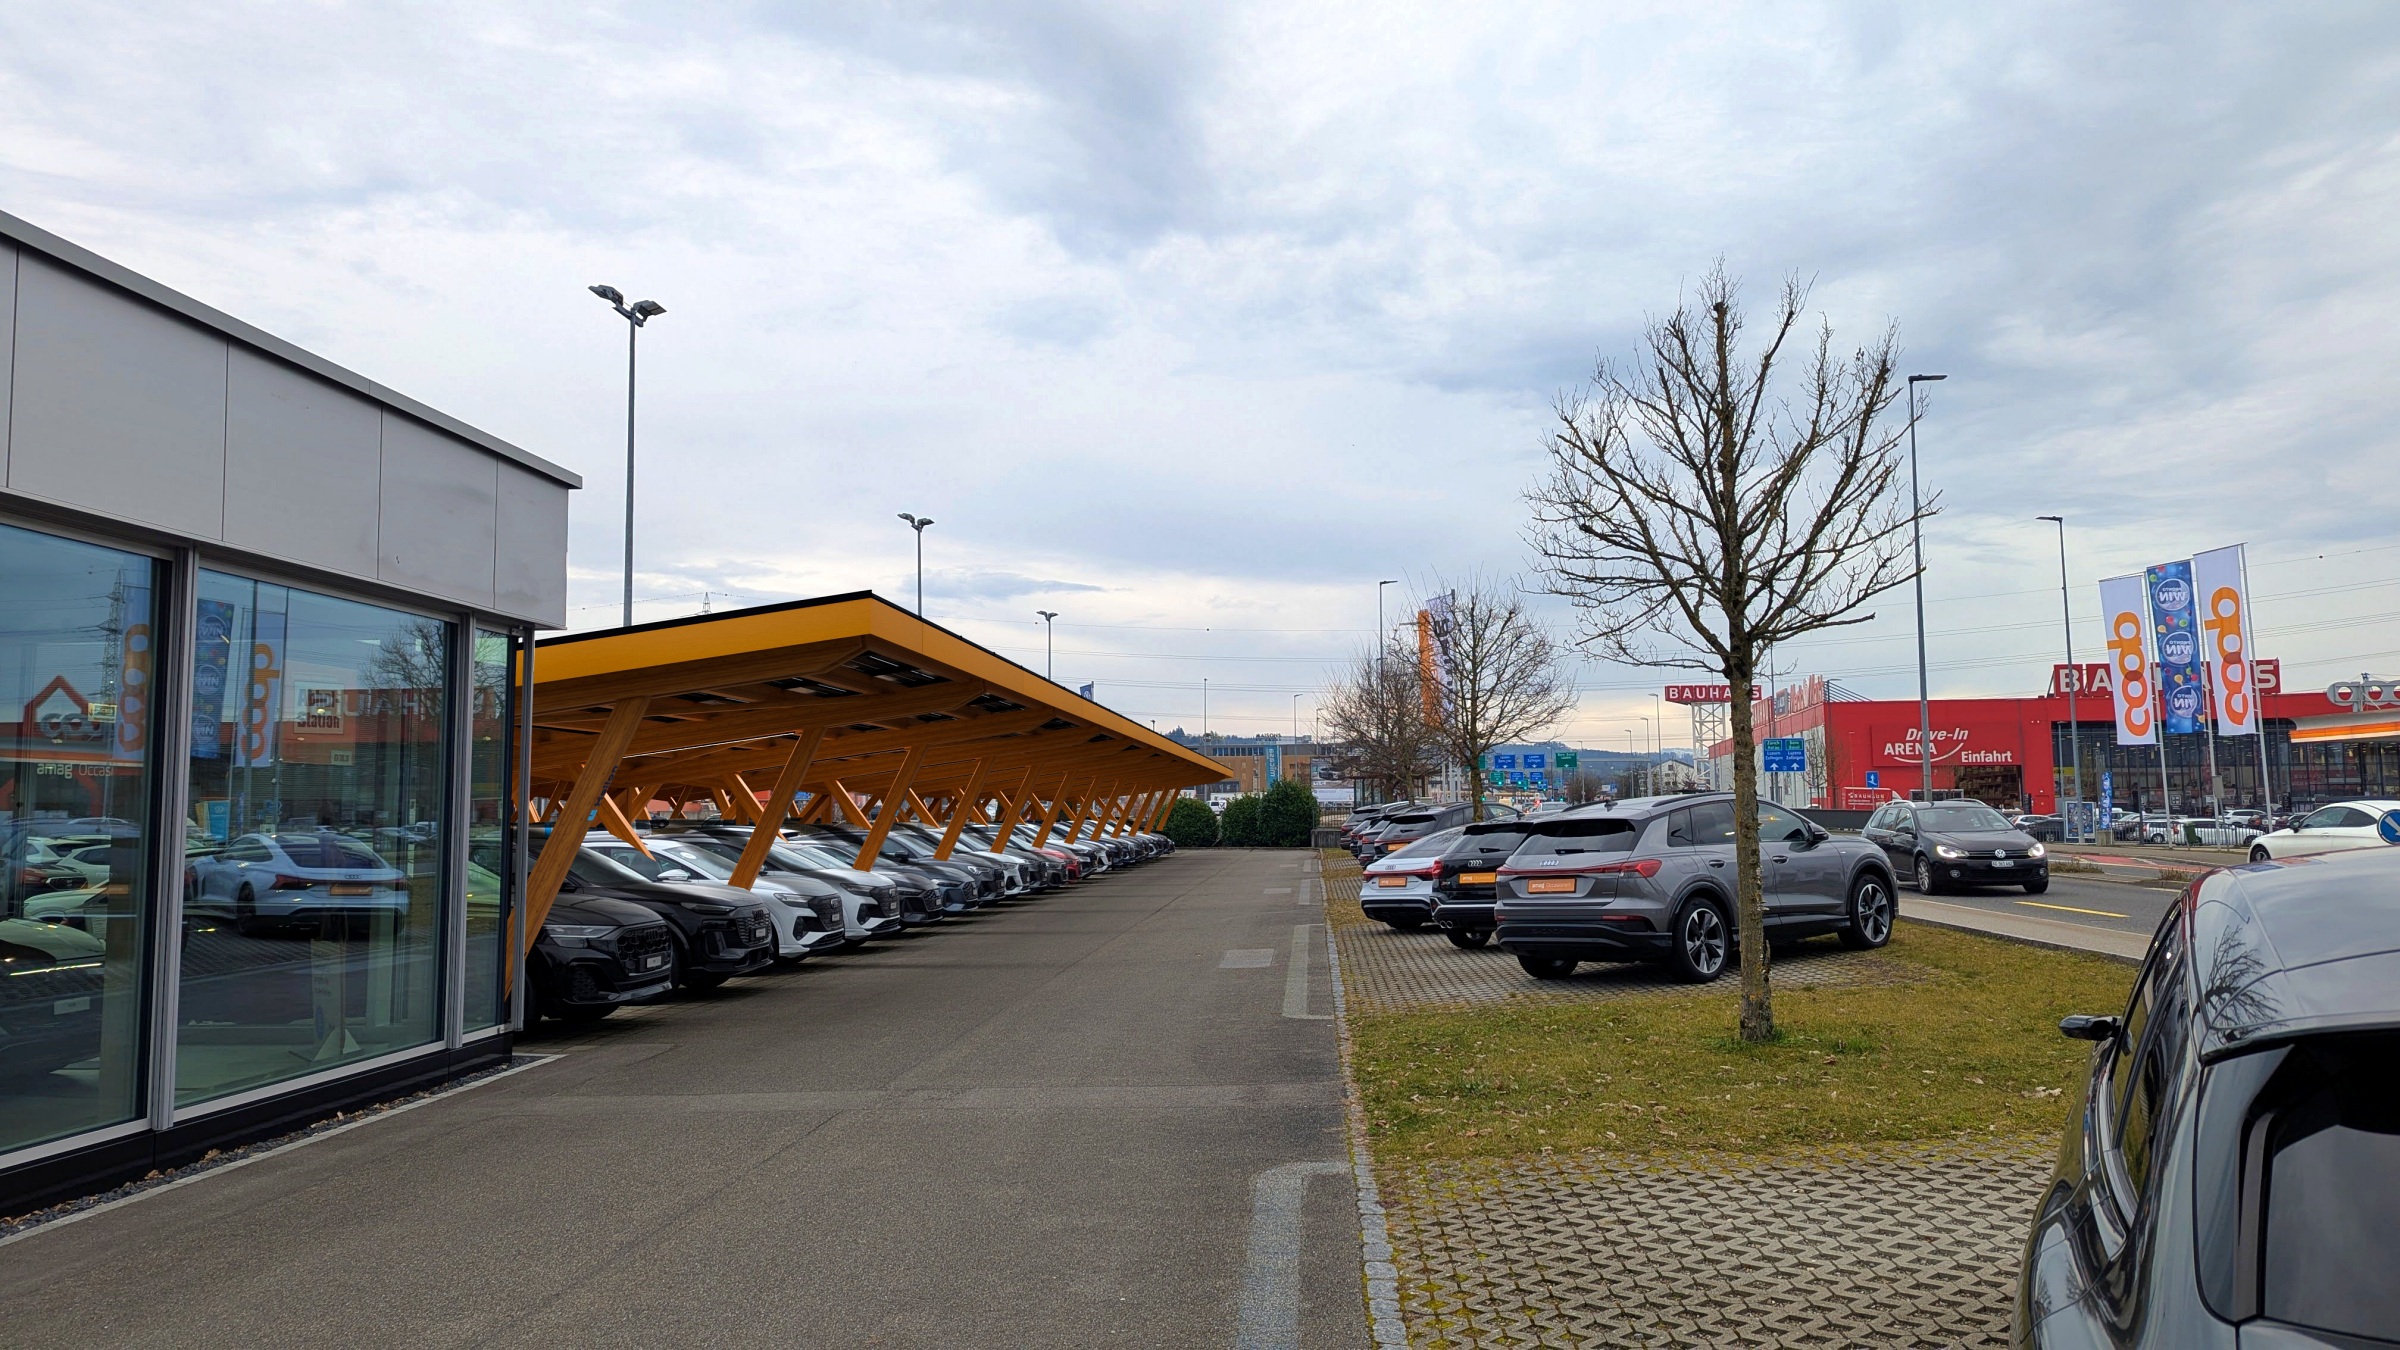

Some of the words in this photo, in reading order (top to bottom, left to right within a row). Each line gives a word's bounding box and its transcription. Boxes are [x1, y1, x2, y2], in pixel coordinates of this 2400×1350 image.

[1669, 687, 1760, 699] BAUHAS
[1905, 727, 1969, 741] Drve-In
[1884, 742, 1938, 756] ARENA
[1961, 750, 2013, 763] Einfahrt
[37, 763, 73, 779] amag
